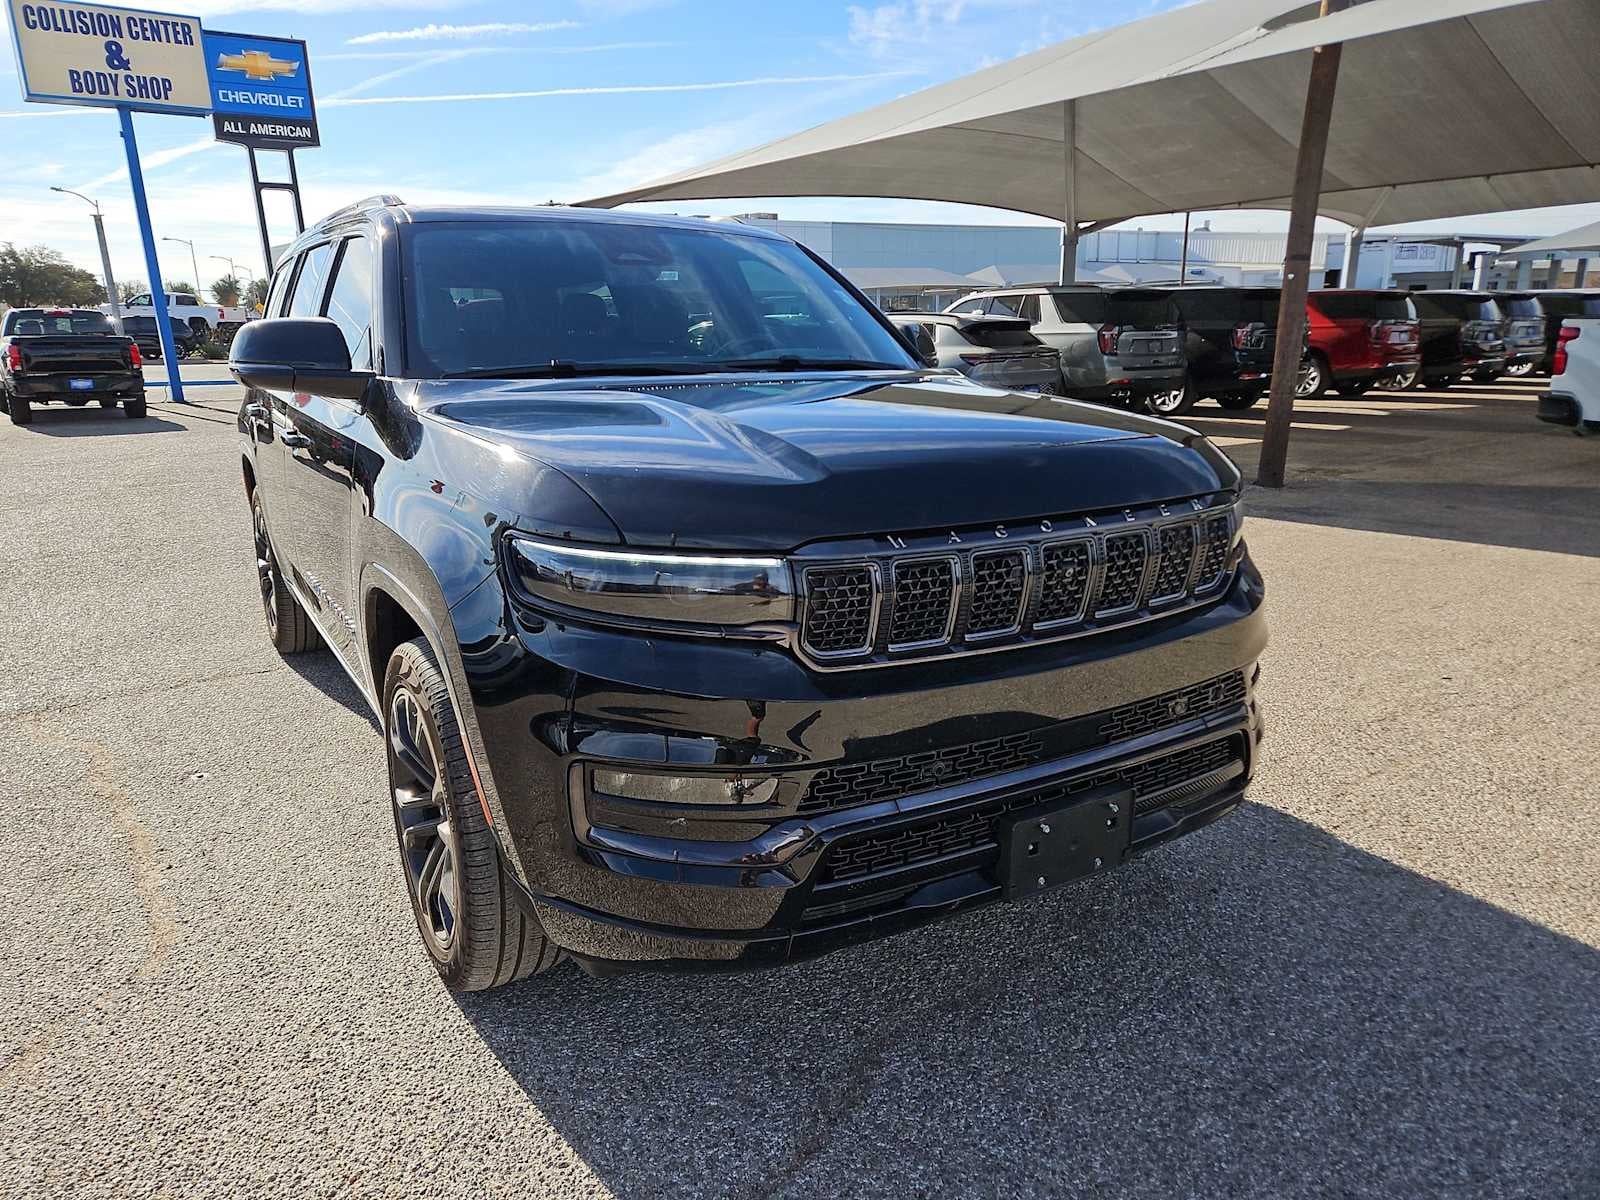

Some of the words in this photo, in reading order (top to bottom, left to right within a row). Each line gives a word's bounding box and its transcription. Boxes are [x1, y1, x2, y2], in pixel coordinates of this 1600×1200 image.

[22, 4, 123, 38] COLLISION
[126, 16, 194, 46] CENTER
[104, 40, 131, 71] &
[68, 69, 119, 96] BODY
[124, 74, 172, 100] SHOP
[218, 89, 304, 109] CHEVROLET
[223, 121, 246, 134] ALL
[249, 122, 311, 138] AMERICAN
[886, 499, 1203, 549] WAGONEER
